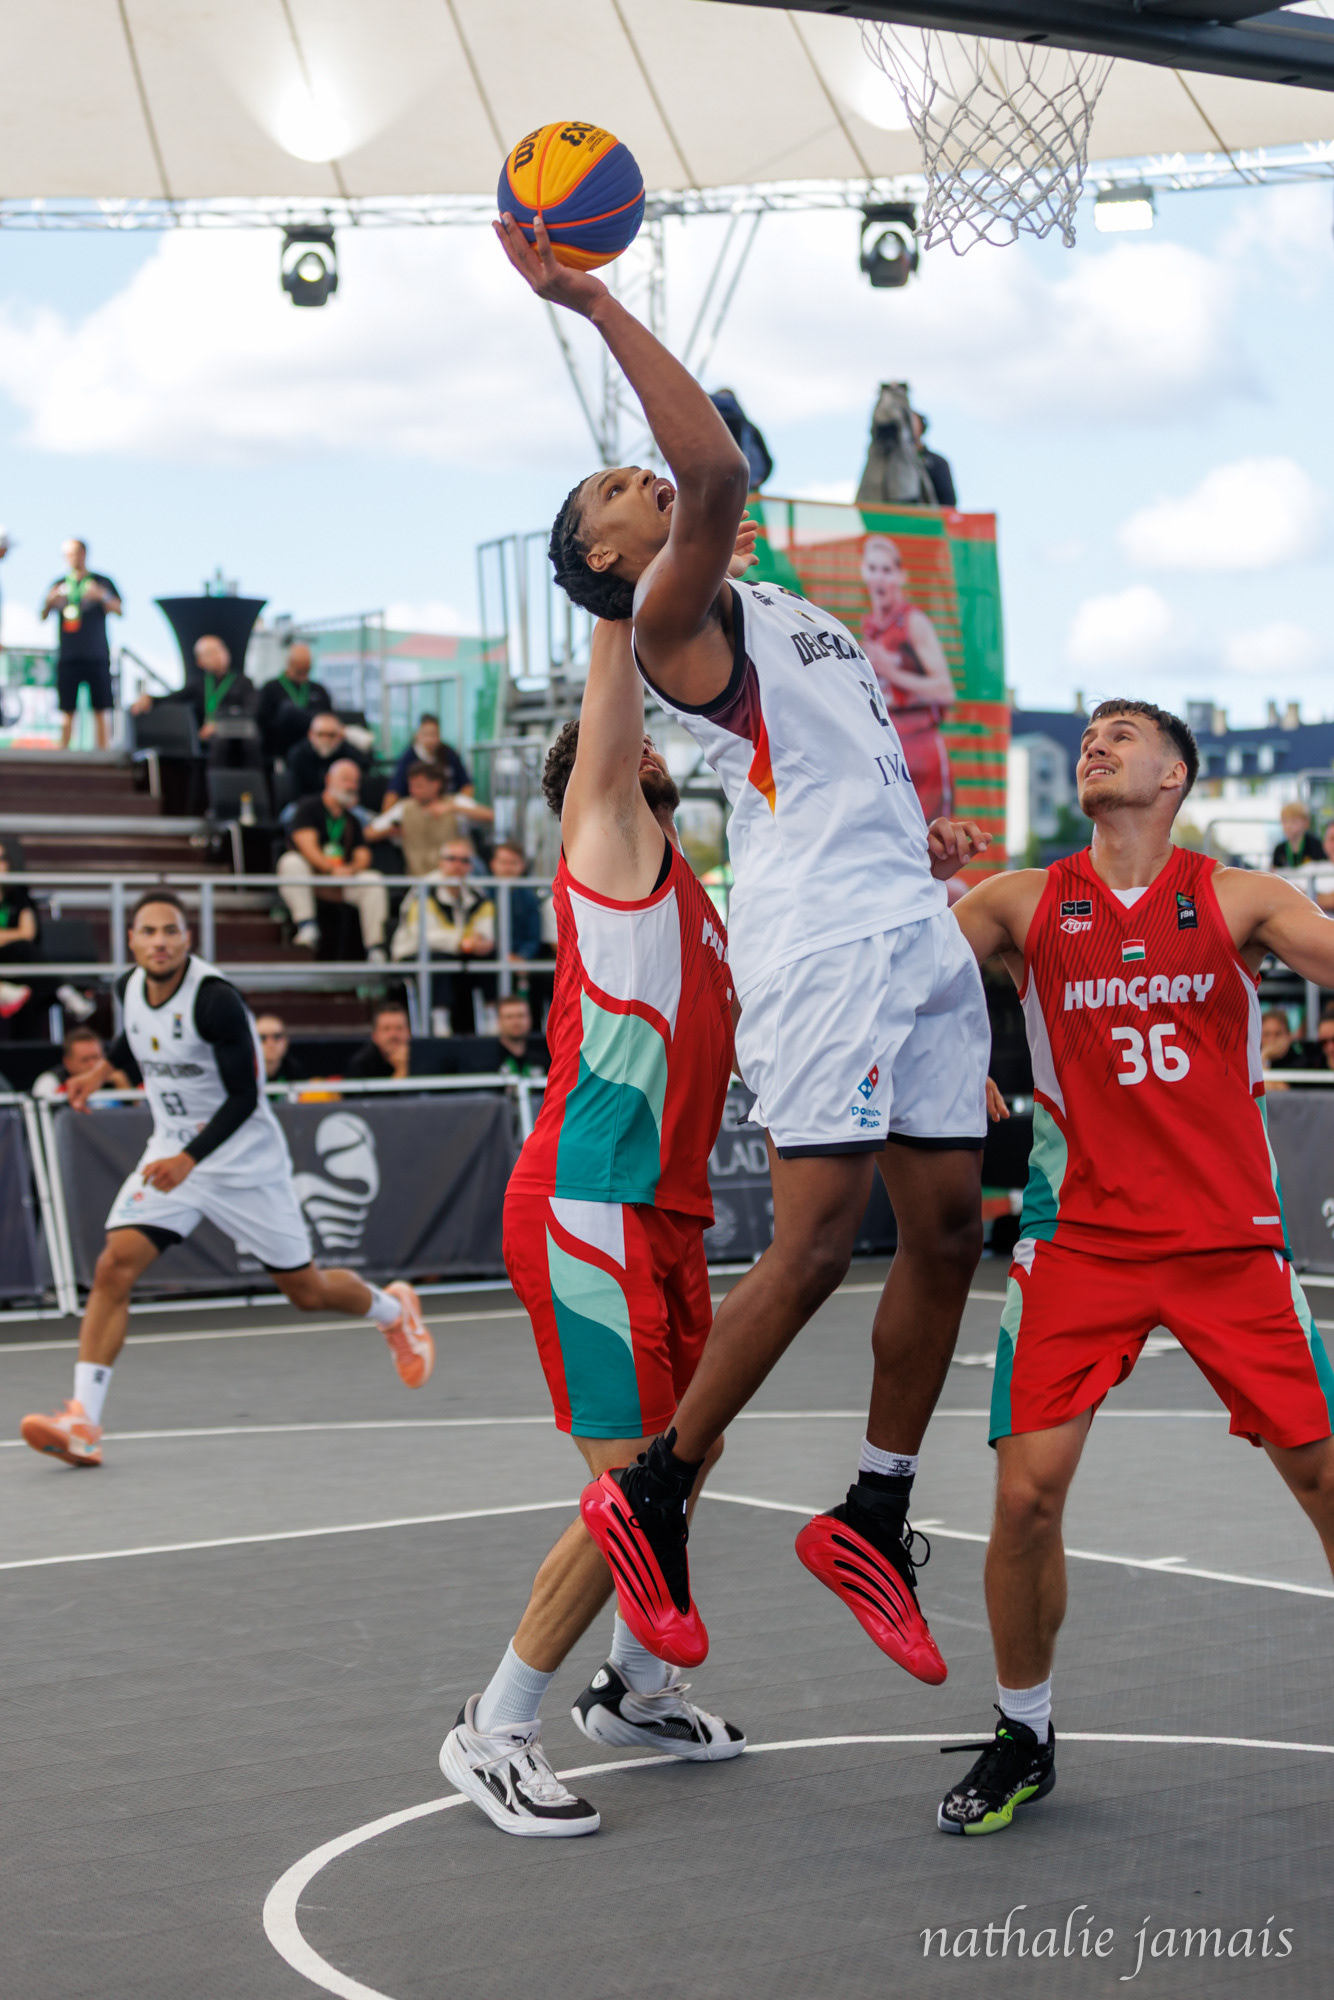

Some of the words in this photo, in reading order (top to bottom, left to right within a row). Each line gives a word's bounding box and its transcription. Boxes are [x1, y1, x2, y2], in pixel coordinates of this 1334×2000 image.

[1180, 909, 1194, 920] FIBA
[1064, 973, 1215, 1011] HUNGARY
[1111, 1022, 1190, 1086] 36
